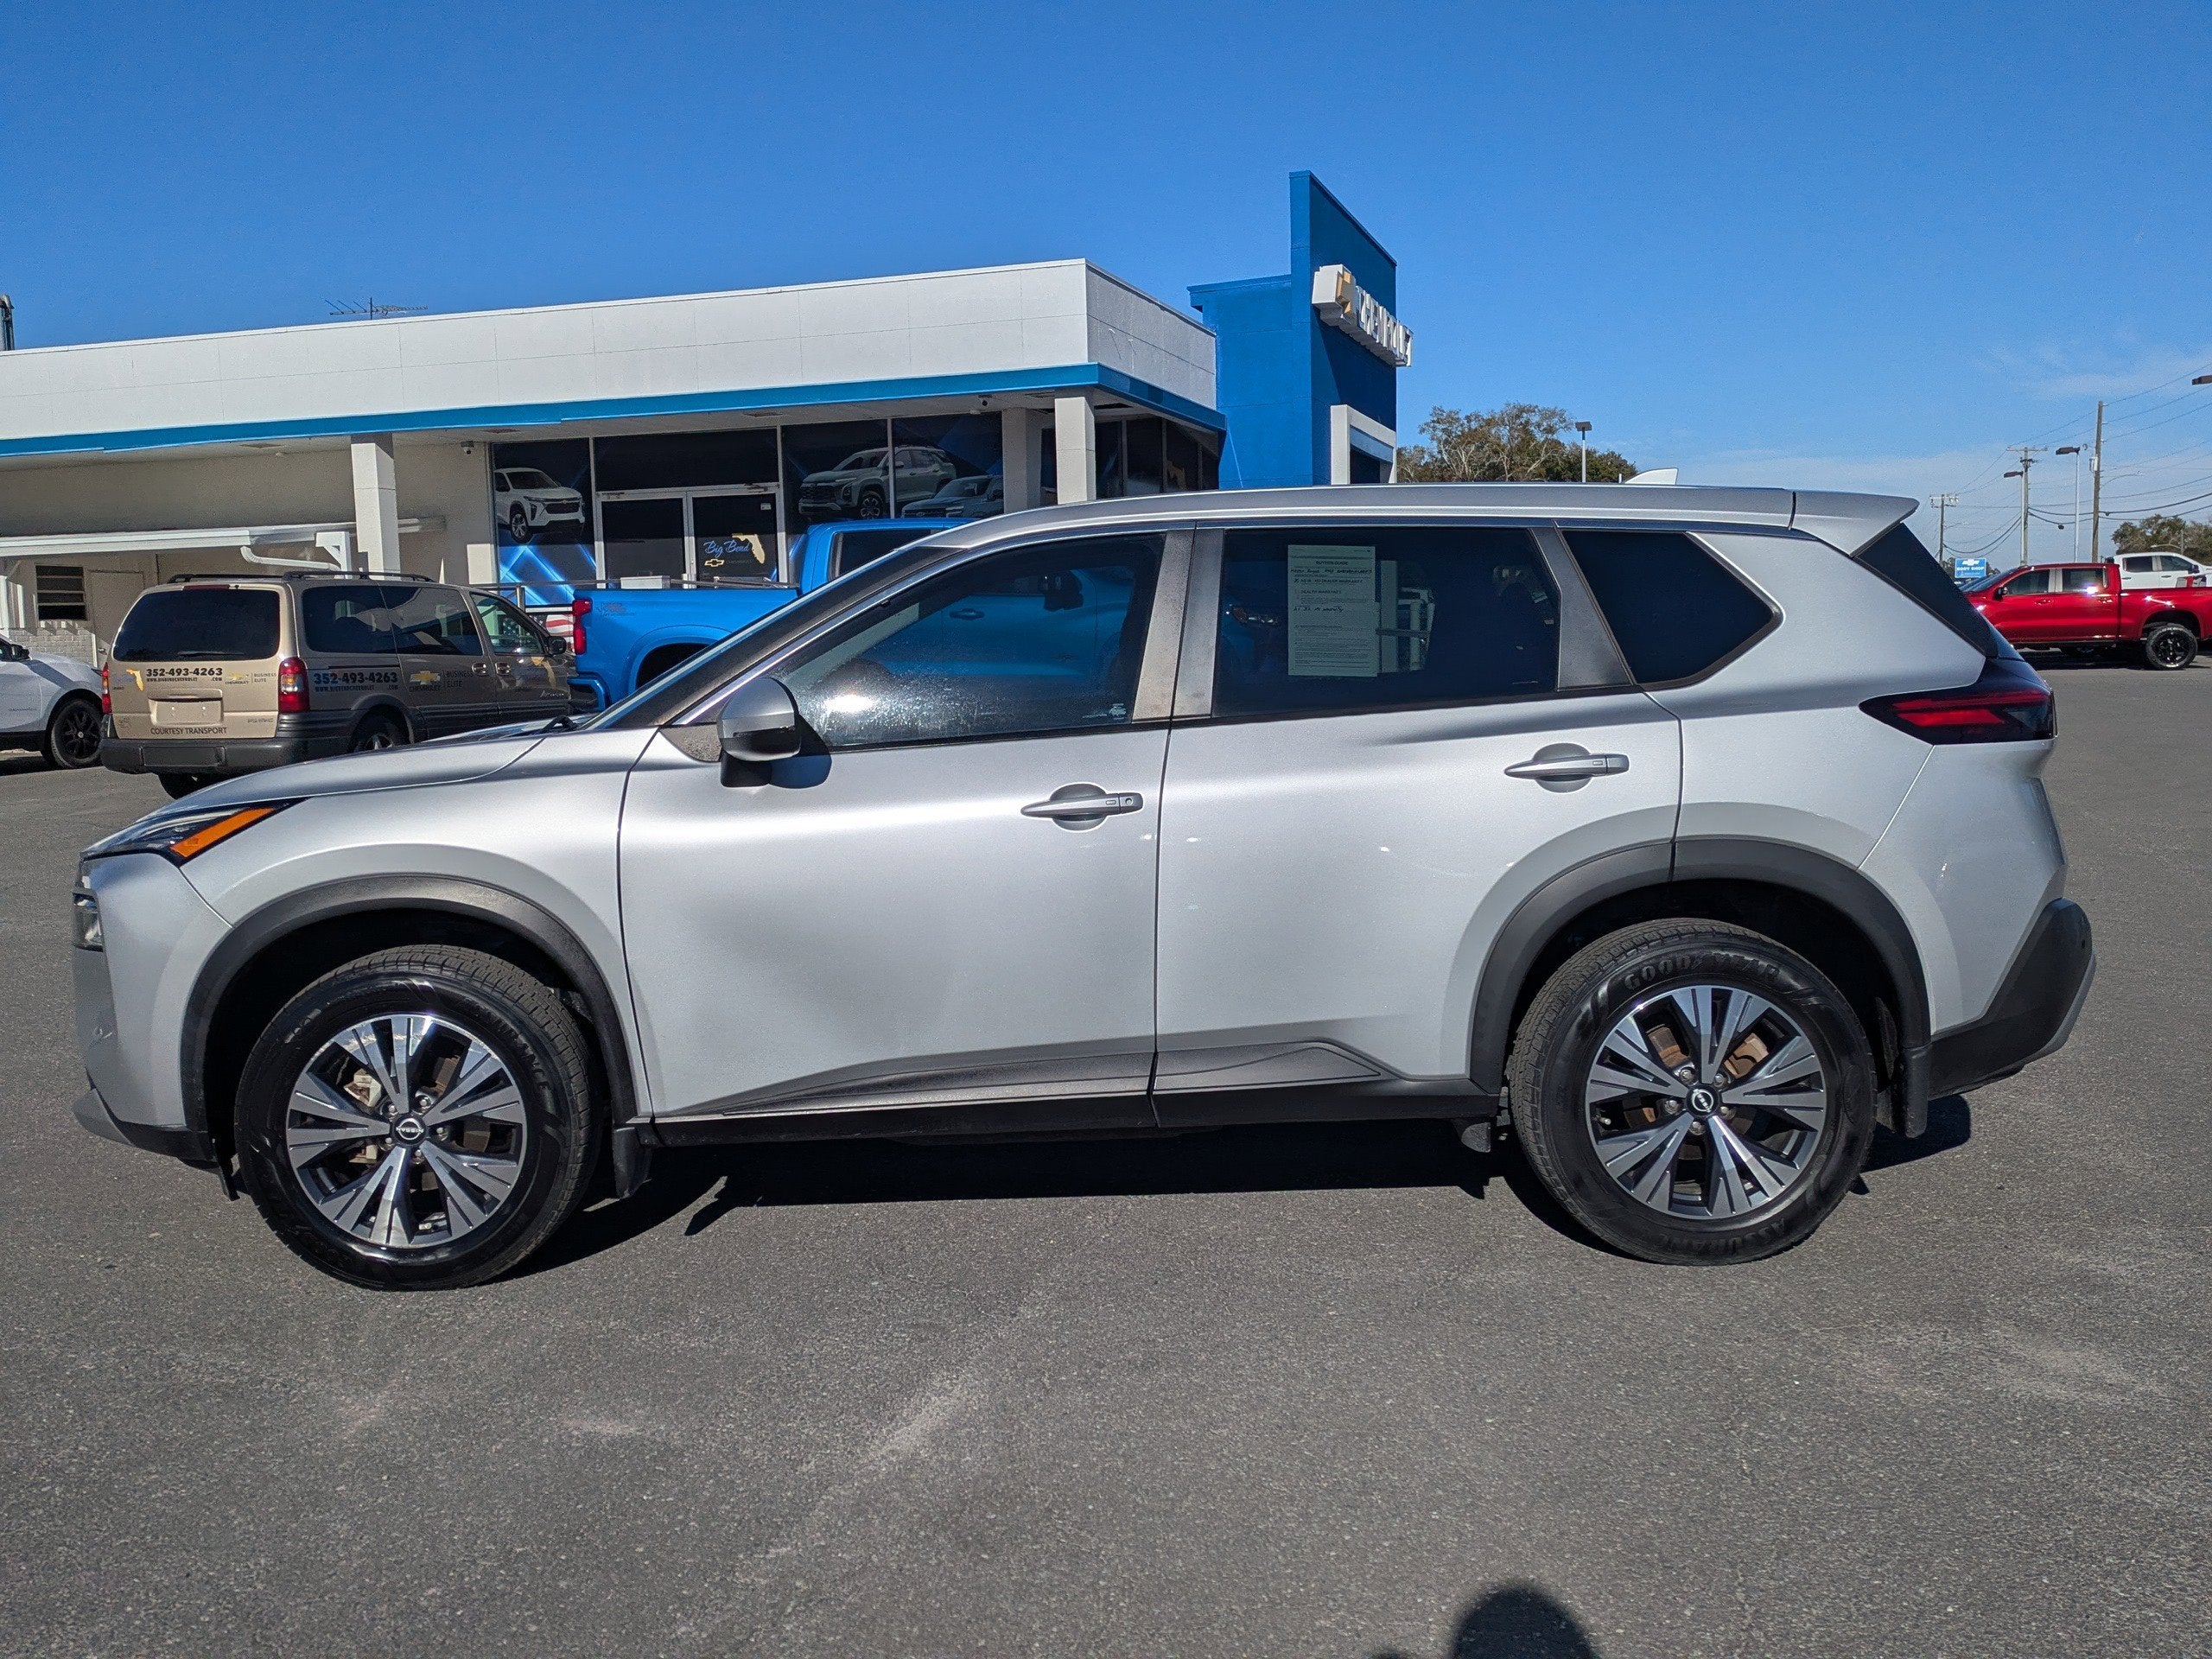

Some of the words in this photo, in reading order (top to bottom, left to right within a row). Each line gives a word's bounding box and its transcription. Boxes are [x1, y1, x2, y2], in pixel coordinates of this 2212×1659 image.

[703, 541, 723, 558] Big
[724, 539, 750, 552] Bend
[146, 668, 222, 677] 352-493-4263
[314, 671, 397, 684] 352-493-4263
